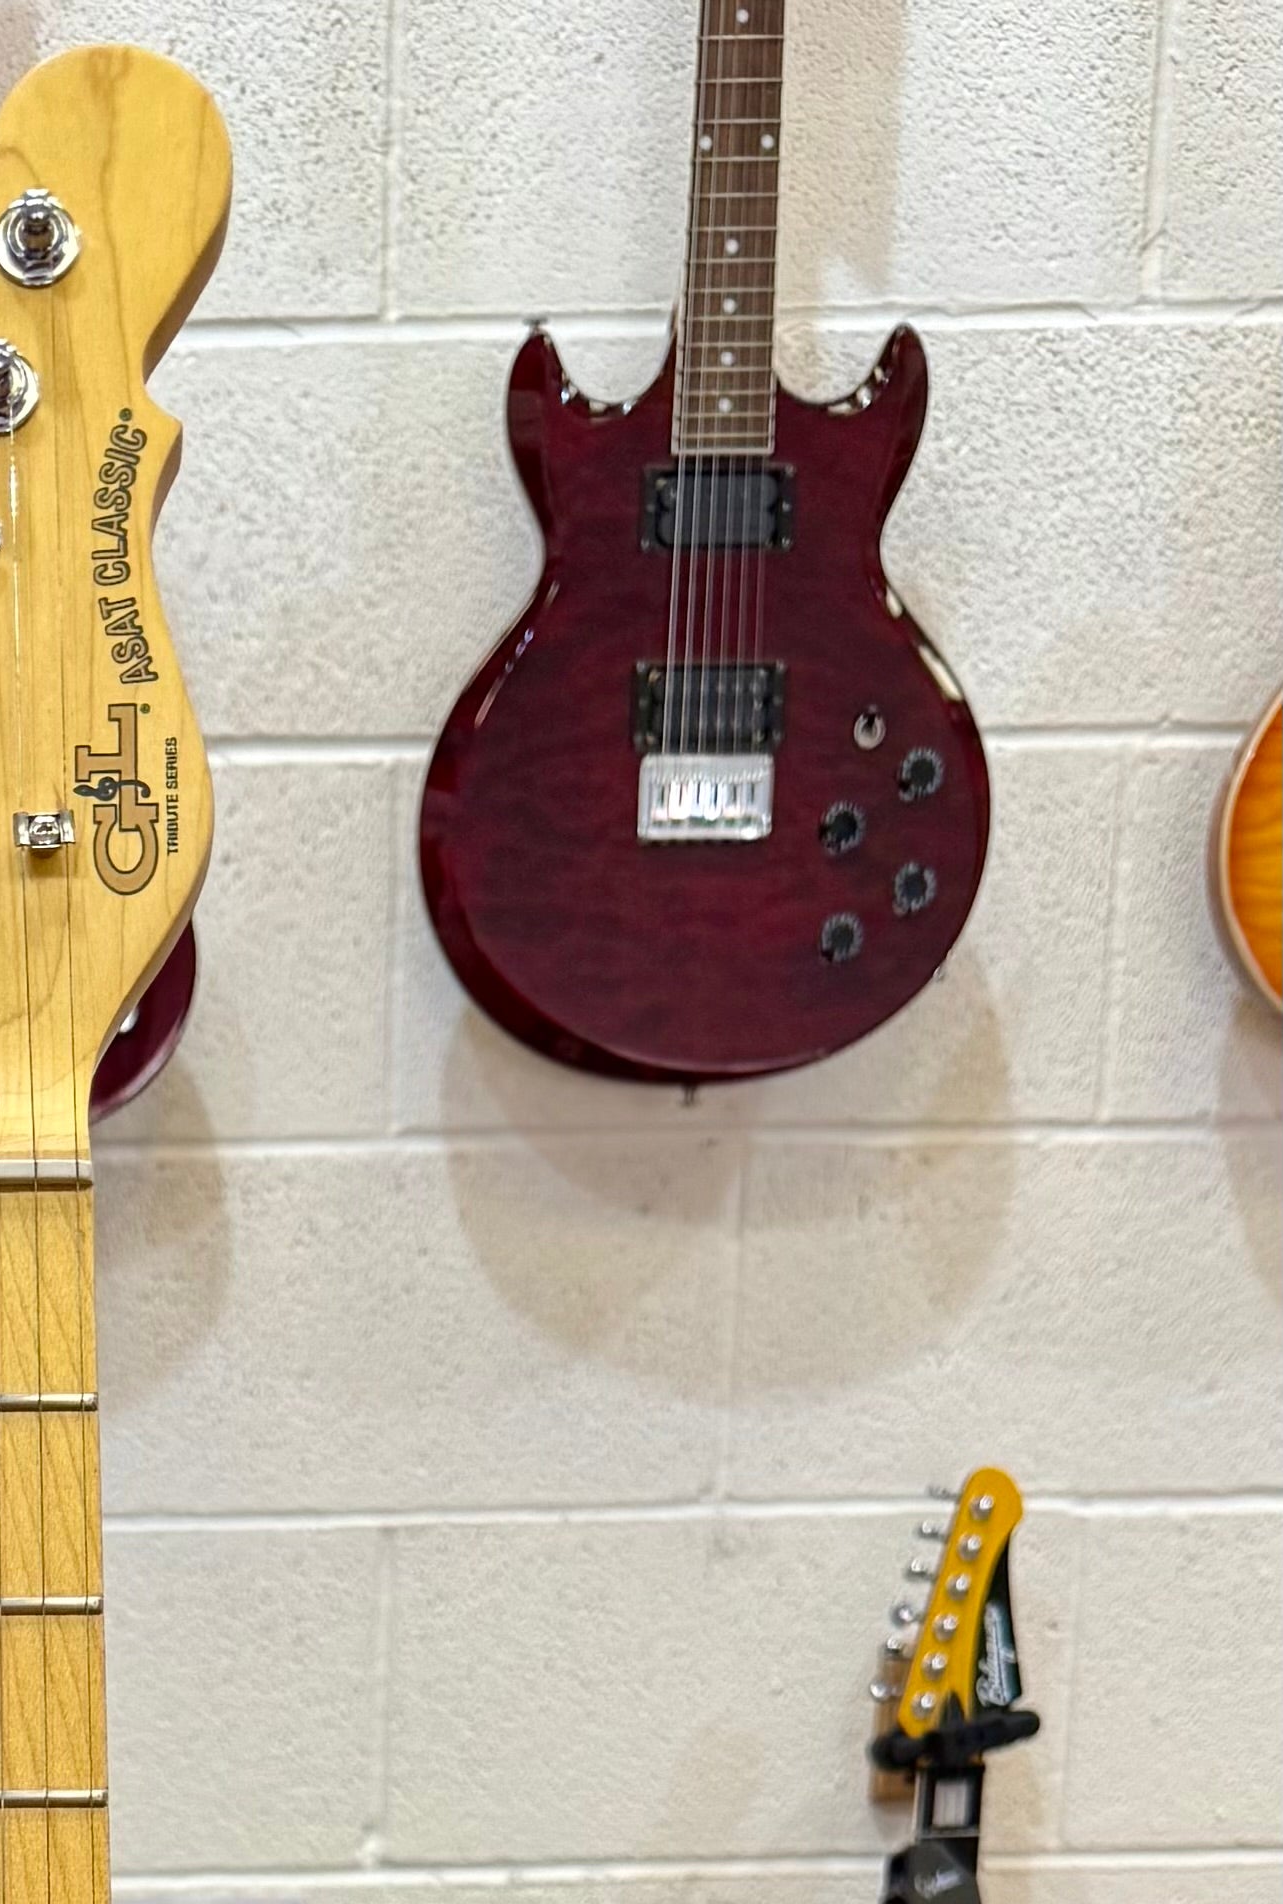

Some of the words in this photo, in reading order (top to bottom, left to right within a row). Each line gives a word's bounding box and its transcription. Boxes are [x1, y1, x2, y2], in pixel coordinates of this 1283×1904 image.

[91, 424, 148, 586] CLASSIC
[98, 597, 159, 684] ASAT
[165, 736, 179, 789] SERIES
[166, 794, 179, 857] TRIBUTE
